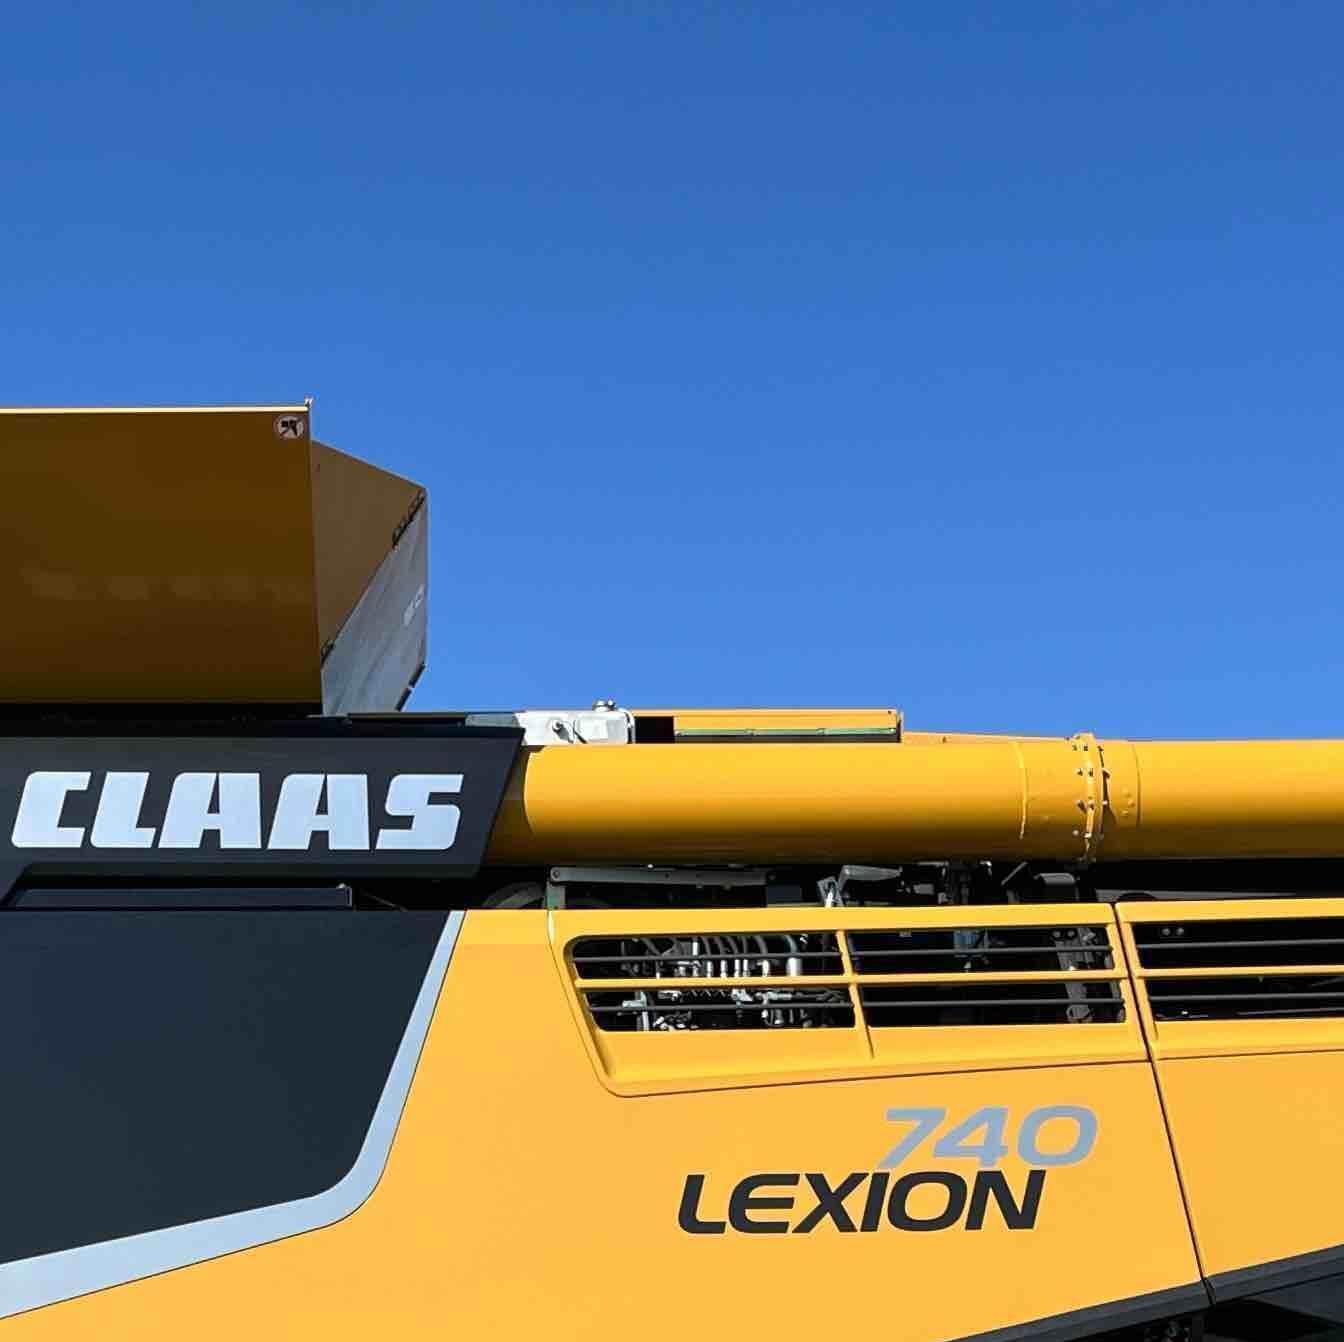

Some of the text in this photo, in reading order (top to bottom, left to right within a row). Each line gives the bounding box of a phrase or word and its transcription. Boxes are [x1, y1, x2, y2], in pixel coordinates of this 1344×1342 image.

[11, 771, 464, 850] CLAAS
[875, 1105, 1098, 1169] 740
[678, 1169, 1047, 1234] LEXION
